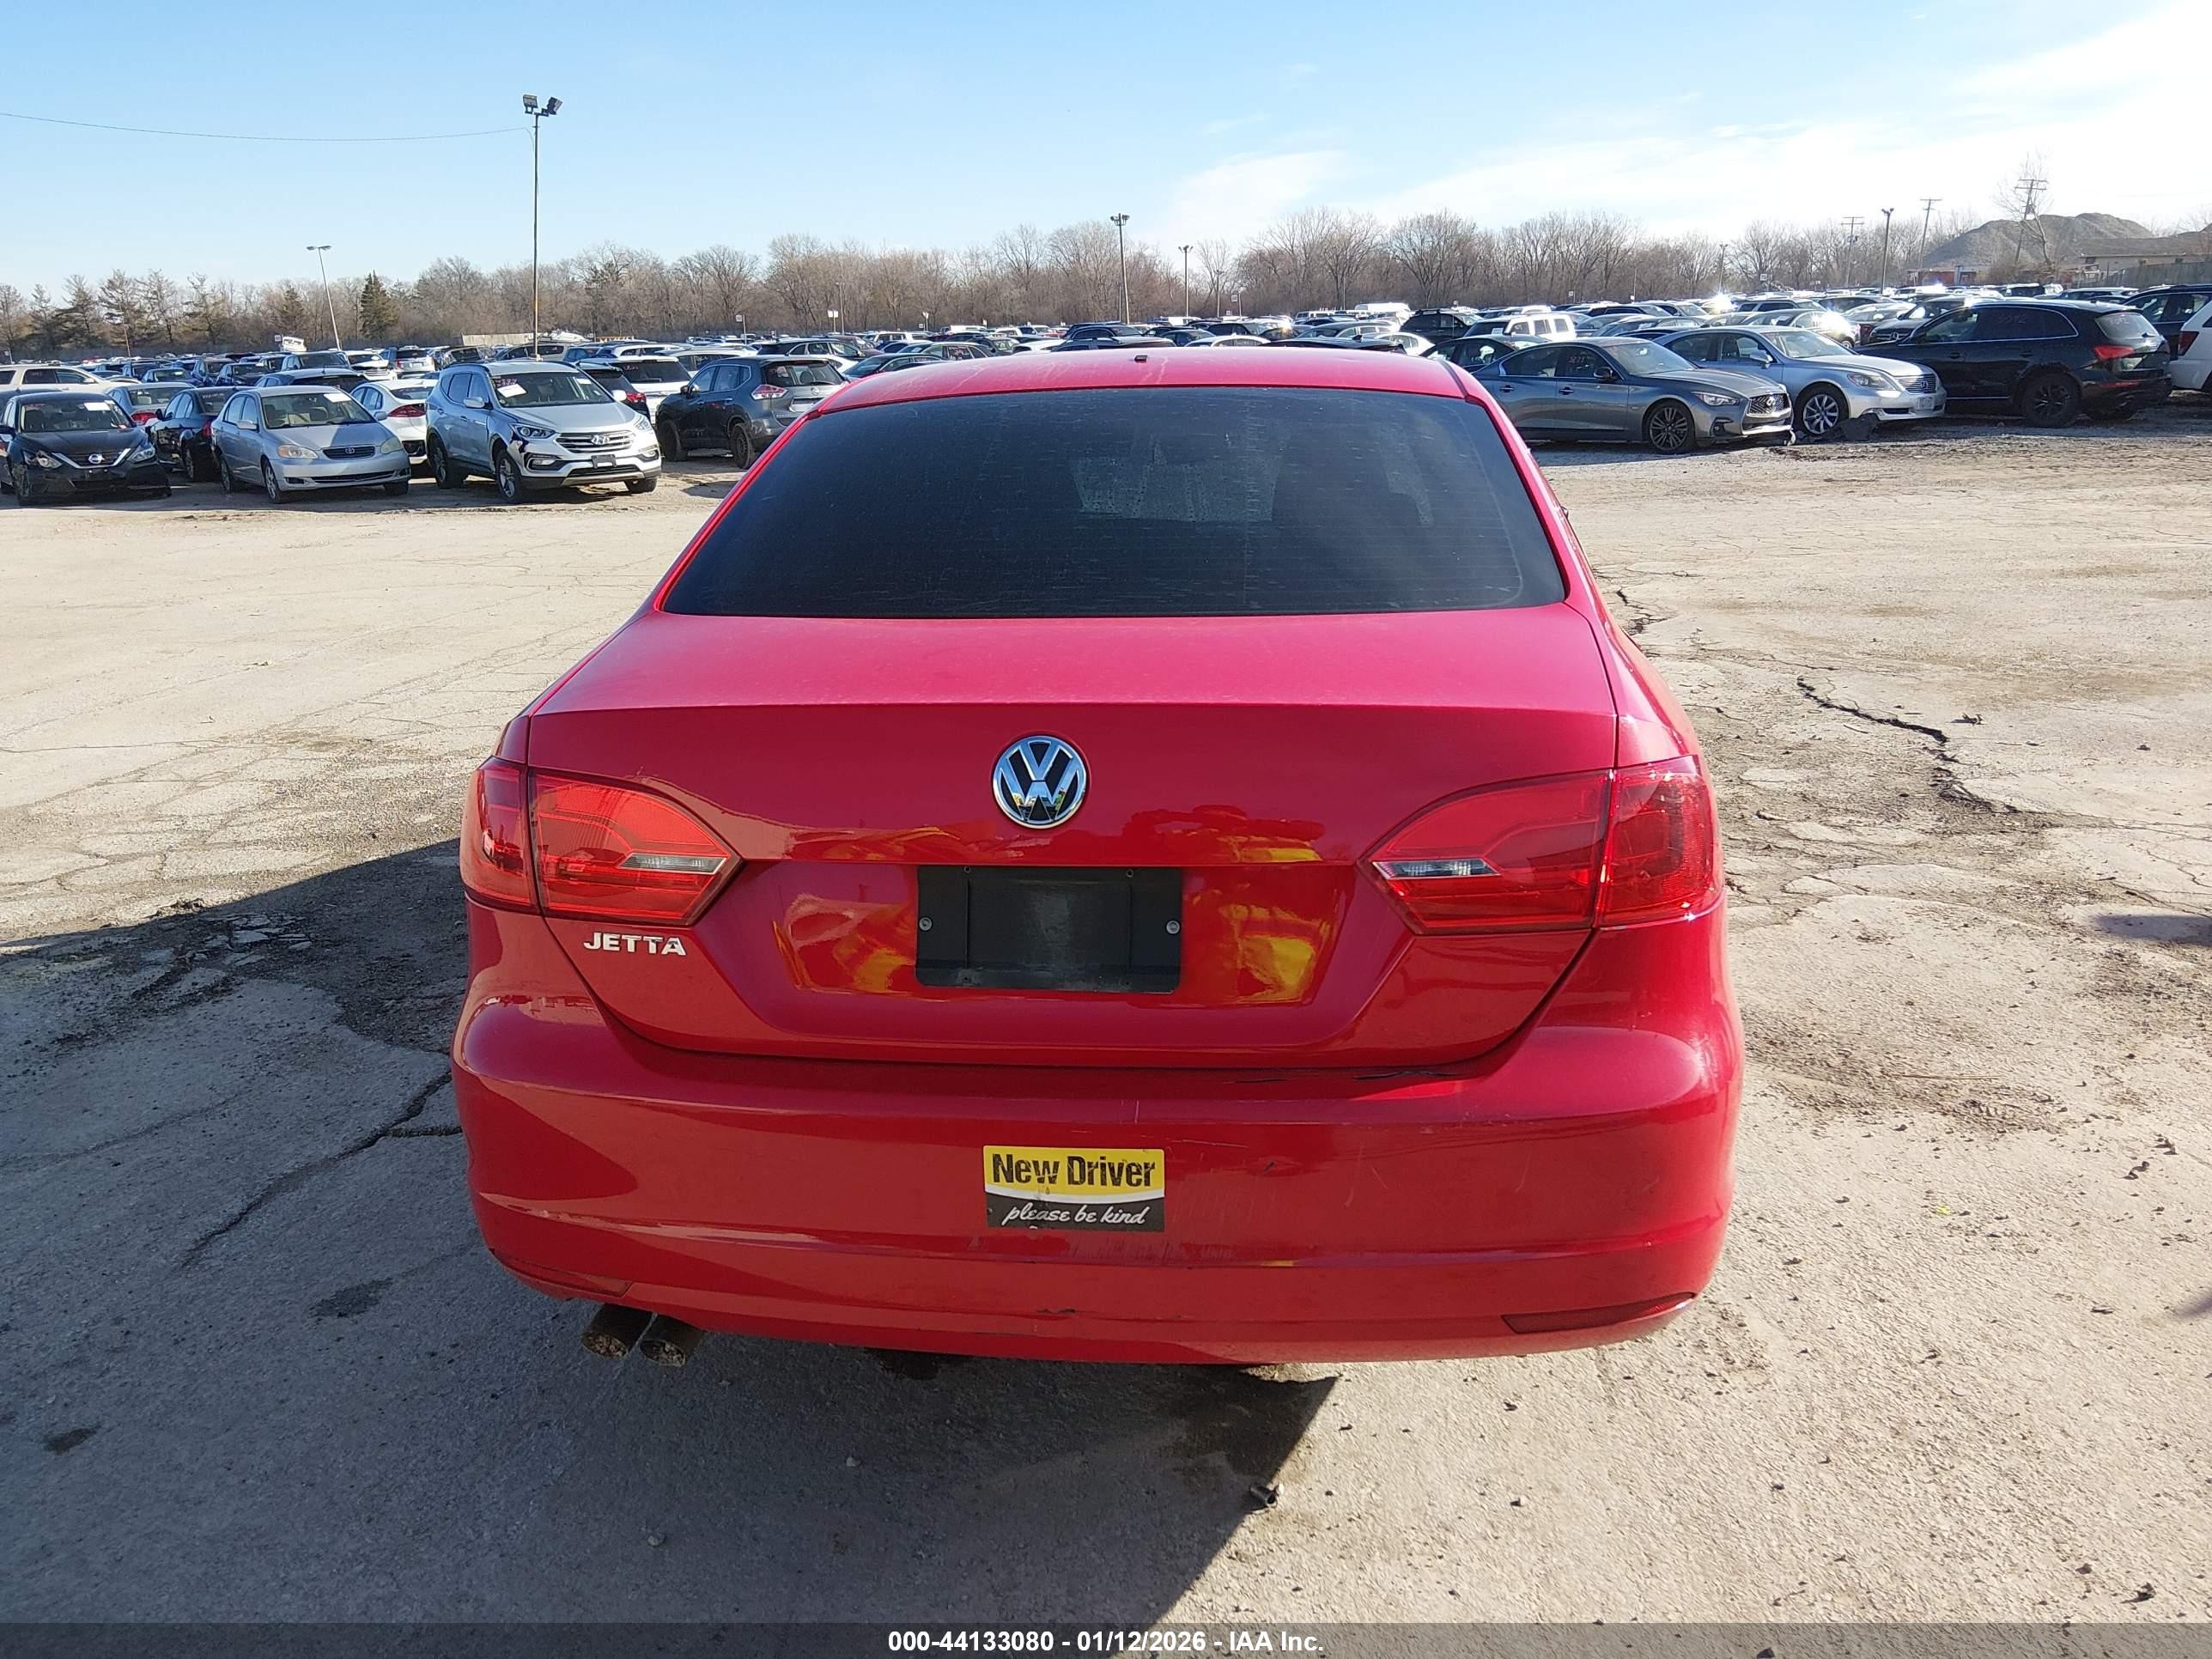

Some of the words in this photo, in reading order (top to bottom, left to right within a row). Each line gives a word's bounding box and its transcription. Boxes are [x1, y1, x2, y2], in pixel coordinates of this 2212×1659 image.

[583, 932, 687, 956] JETTA
[992, 1153, 1060, 1184] New
[1067, 1156, 1156, 1188] Driver
[1002, 1202, 1071, 1226] please
[1074, 1205, 1097, 1224] be
[1100, 1206, 1151, 1224] kind
